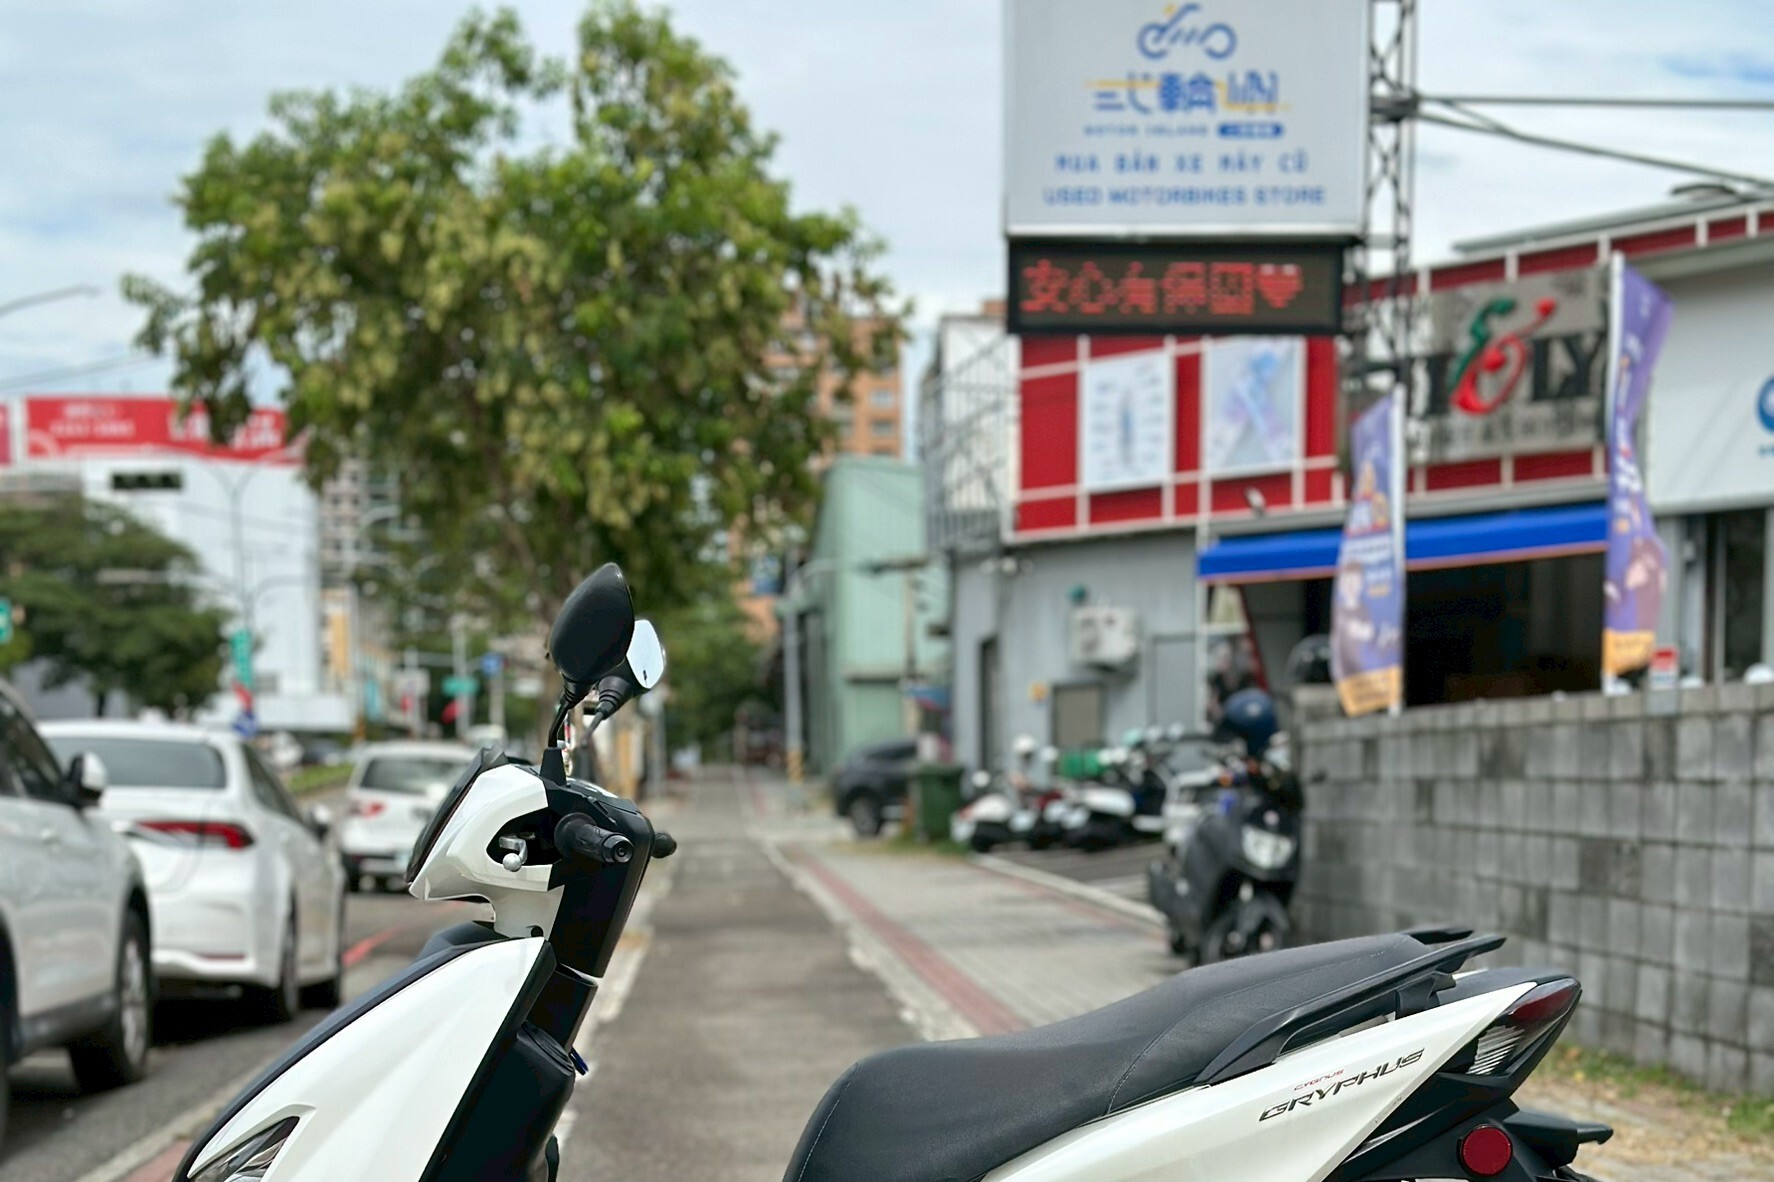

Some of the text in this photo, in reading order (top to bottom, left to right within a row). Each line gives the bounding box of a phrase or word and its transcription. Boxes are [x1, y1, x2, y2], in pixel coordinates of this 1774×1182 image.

[1043, 187, 1101, 205] USED
[1255, 187, 1326, 205] STORE
[1259, 1048, 1425, 1122] GRYPHUS
